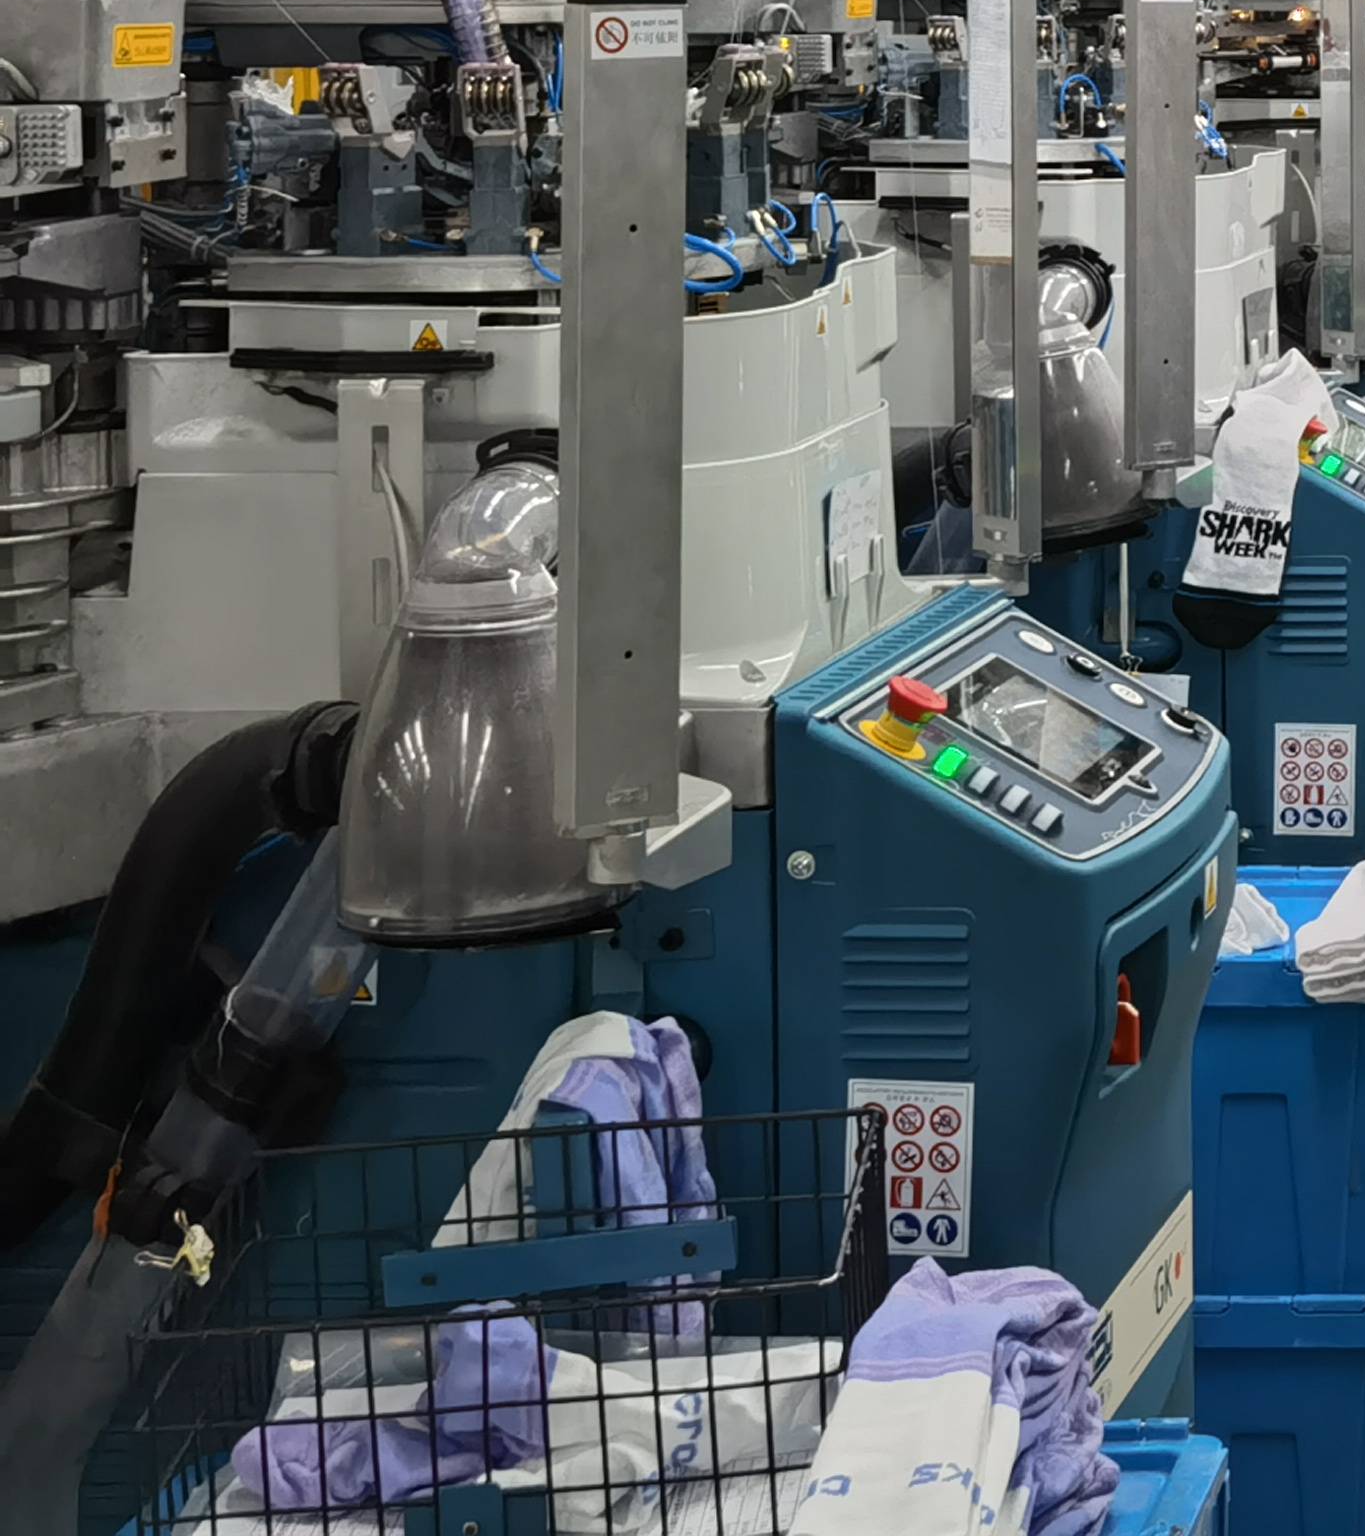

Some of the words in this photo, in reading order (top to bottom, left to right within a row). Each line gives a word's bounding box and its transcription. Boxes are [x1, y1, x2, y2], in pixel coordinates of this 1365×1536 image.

[1223, 499, 1281, 520] Discovery
[1199, 509, 1292, 548] SHARK
[1214, 539, 1266, 559] WEEK
[1154, 1251, 1173, 1314] GK
